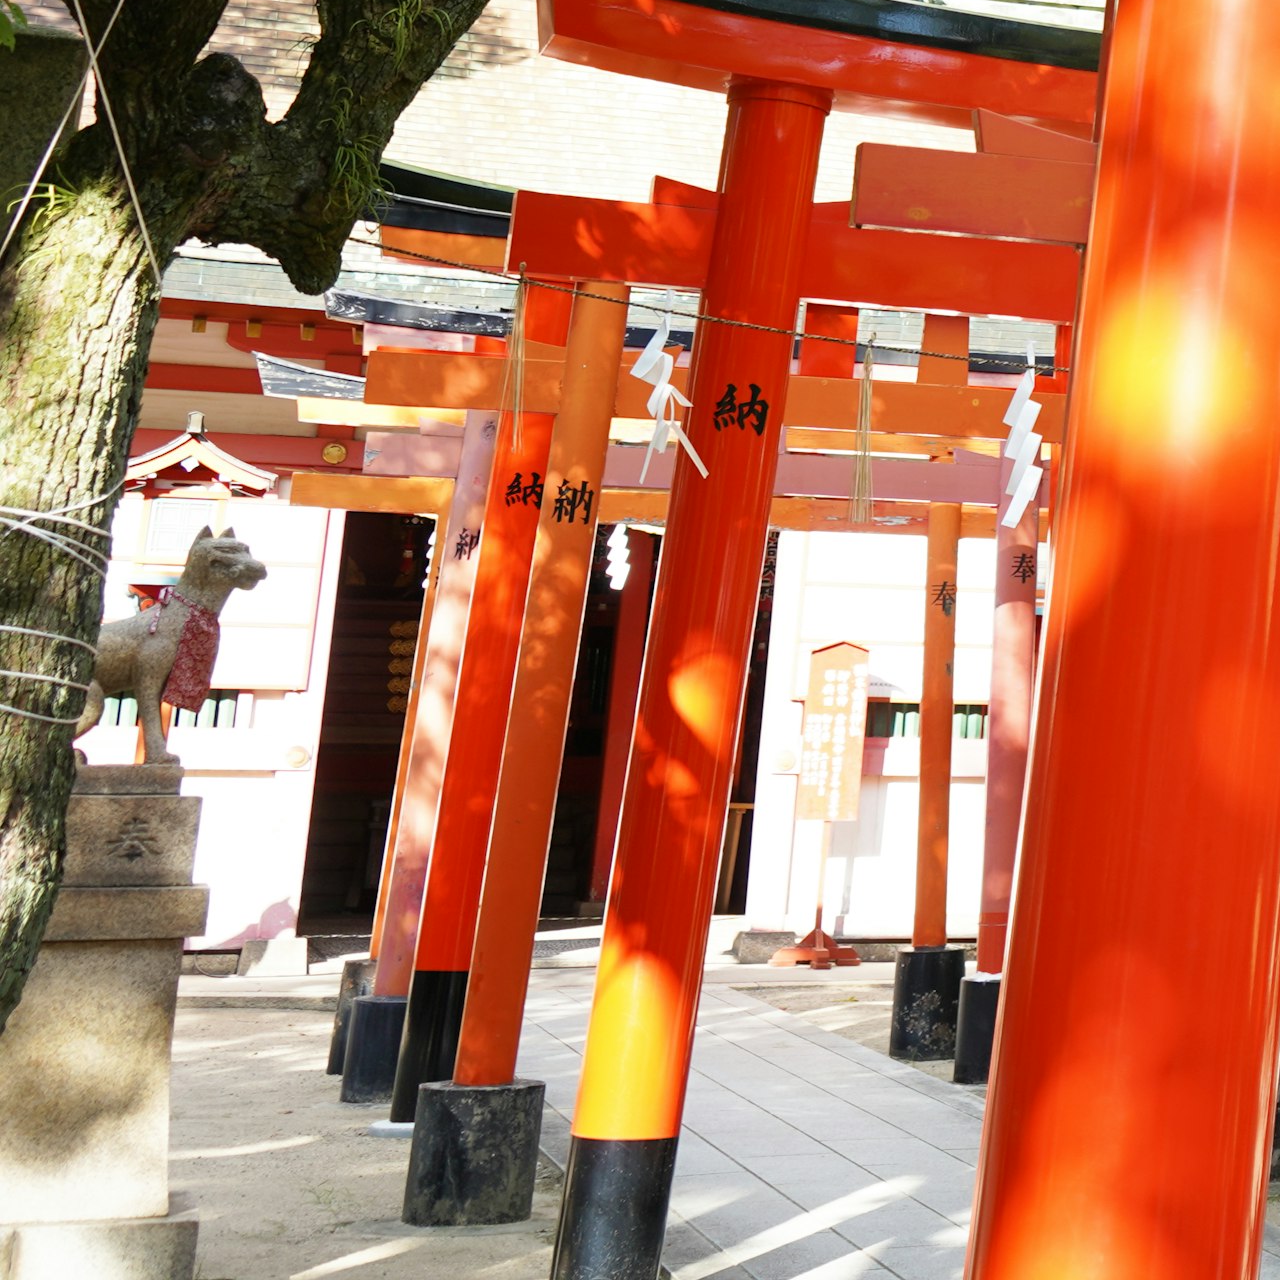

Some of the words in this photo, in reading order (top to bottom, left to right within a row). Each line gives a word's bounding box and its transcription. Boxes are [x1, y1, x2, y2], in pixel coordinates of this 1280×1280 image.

[713, 383, 769, 436] 納
[505, 472, 545, 510] 納
[552, 478, 595, 525] 納
[1011, 553, 1035, 584] 奉
[931, 581, 958, 613] 奉
[105, 817, 163, 862] 奉
